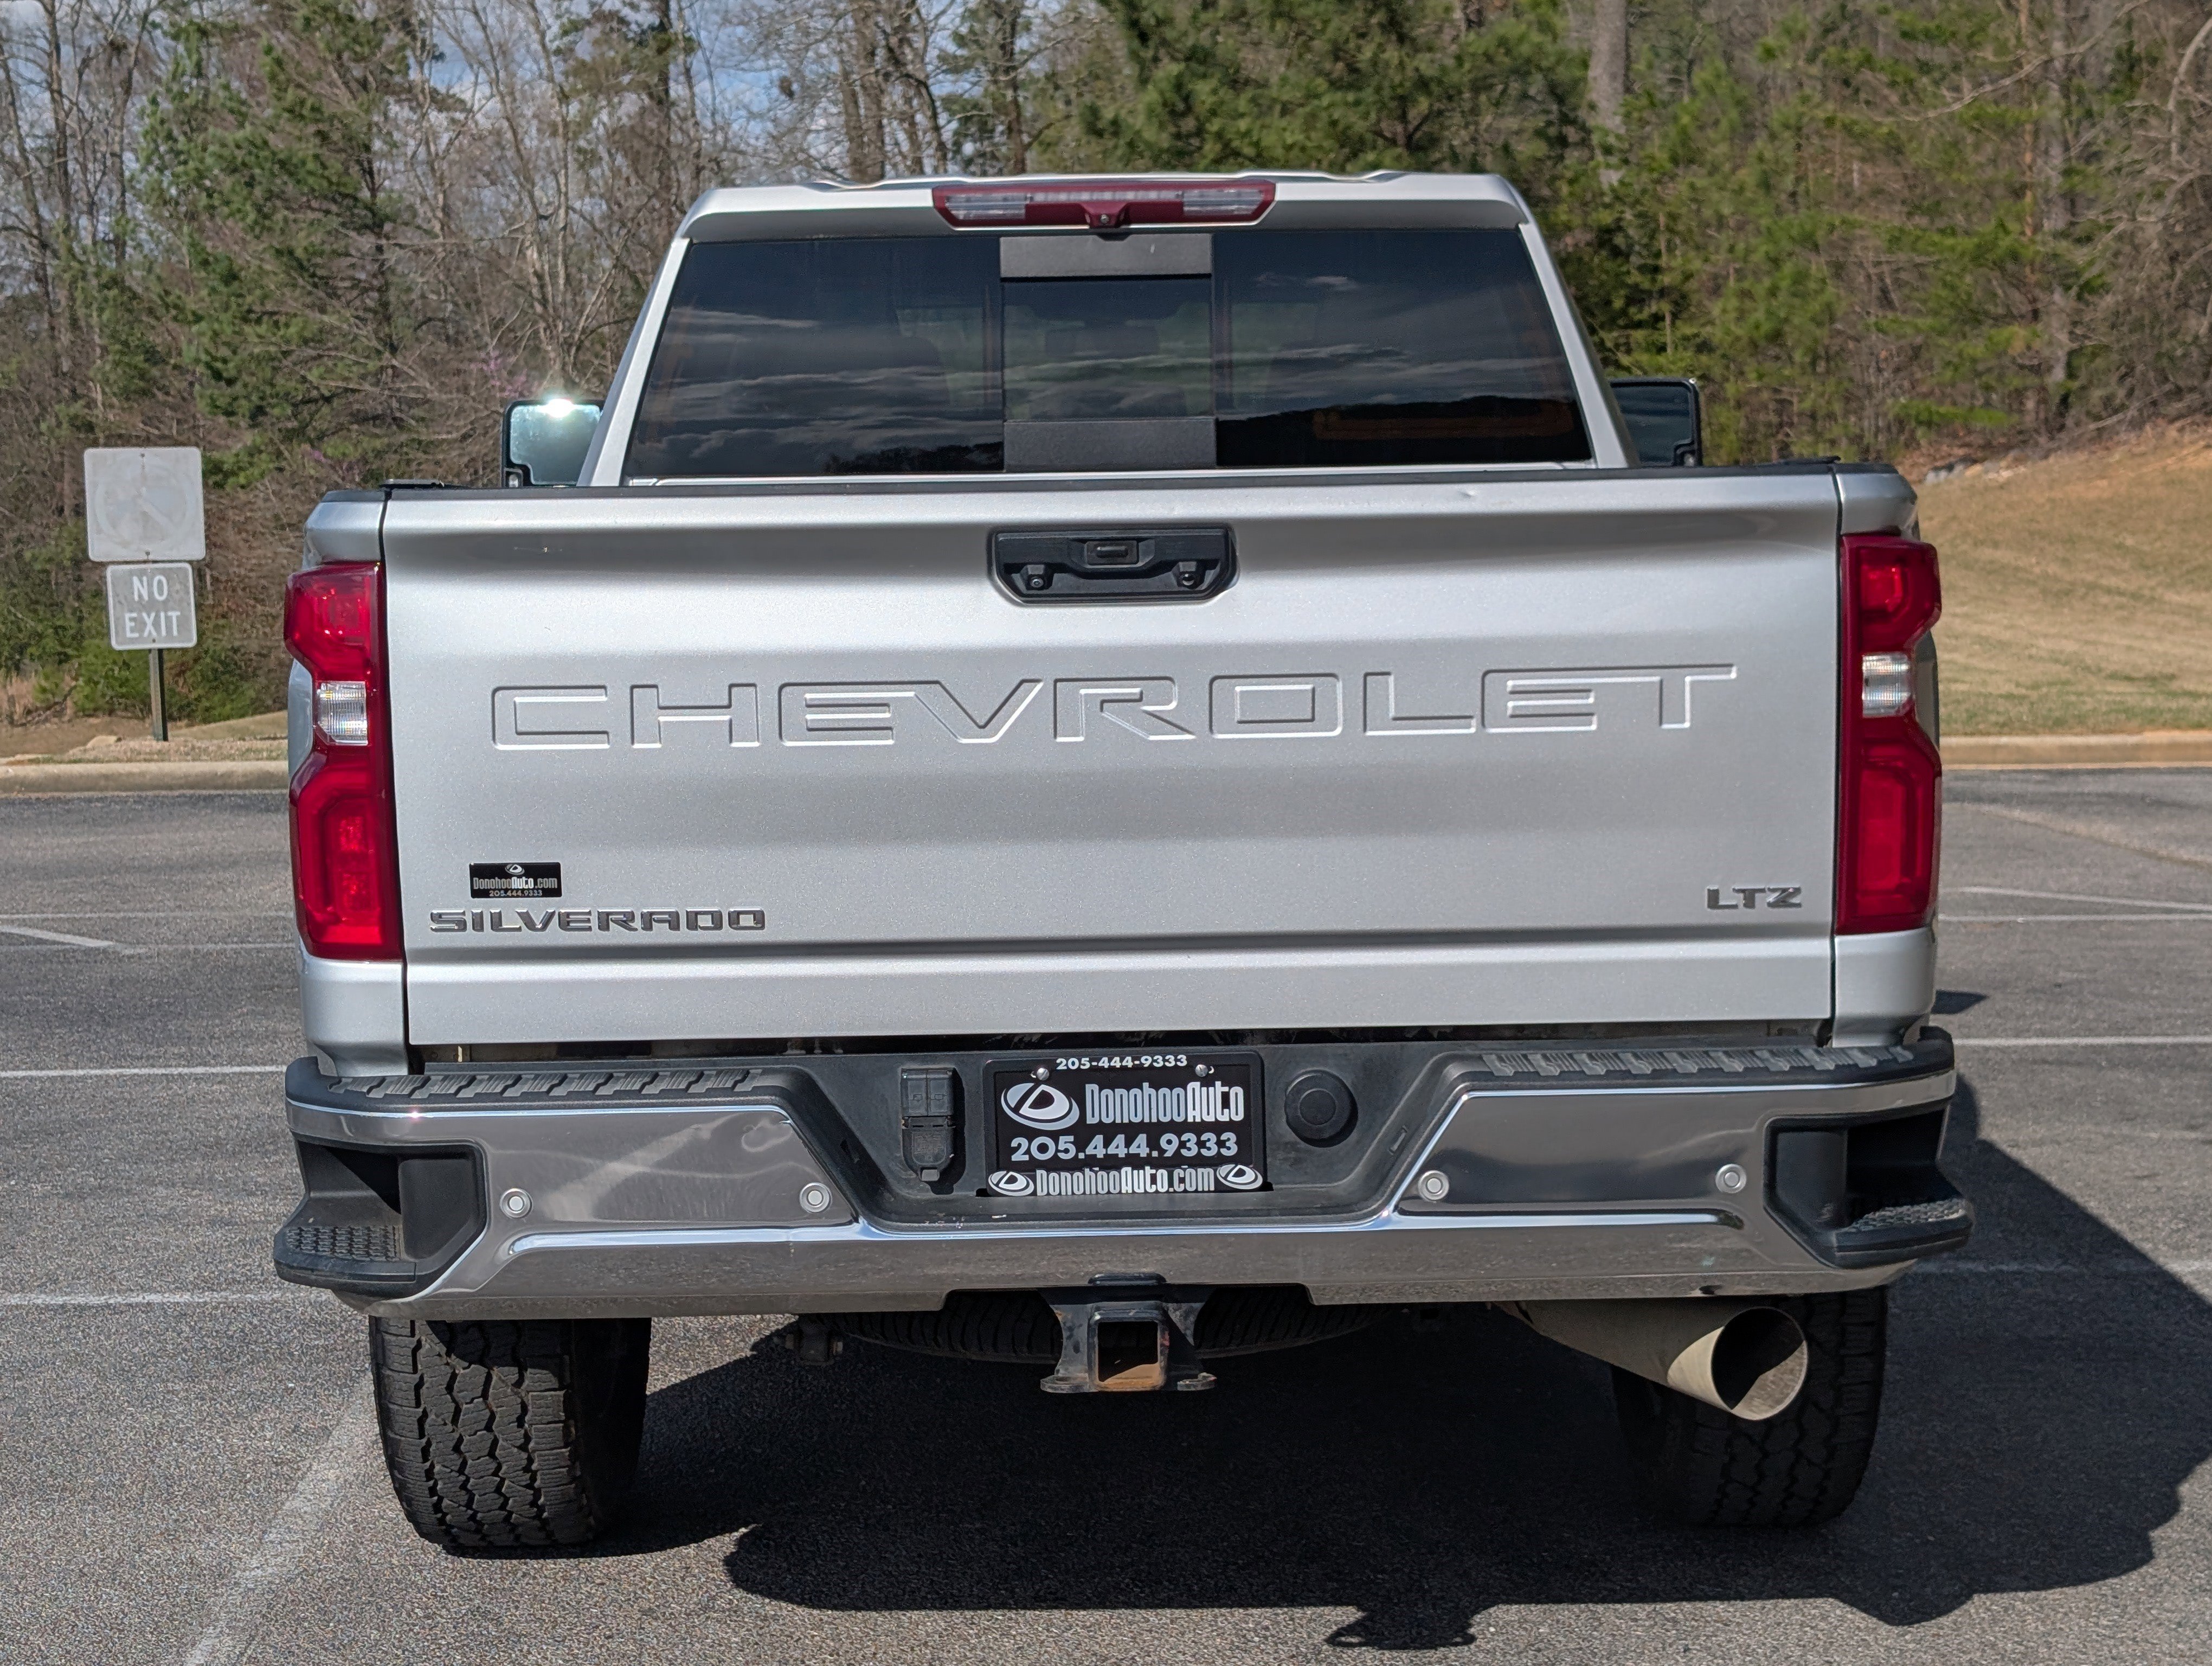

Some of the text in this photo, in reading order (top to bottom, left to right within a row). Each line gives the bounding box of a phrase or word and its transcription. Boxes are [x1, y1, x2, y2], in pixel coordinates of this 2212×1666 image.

[133, 575, 168, 601] NO
[125, 611, 181, 638] EXIT
[491, 663, 1737, 750] CHEVROLET
[1707, 885, 1802, 909] LTZ
[430, 907, 766, 932] SILVERADO
[1056, 1054, 1188, 1070] 205-444-9333
[1085, 1081, 1244, 1124] DonohooAuto
[1011, 1132, 1238, 1161] 205.444.9333
[1036, 1166, 1215, 1196] DonohooAuto.com
